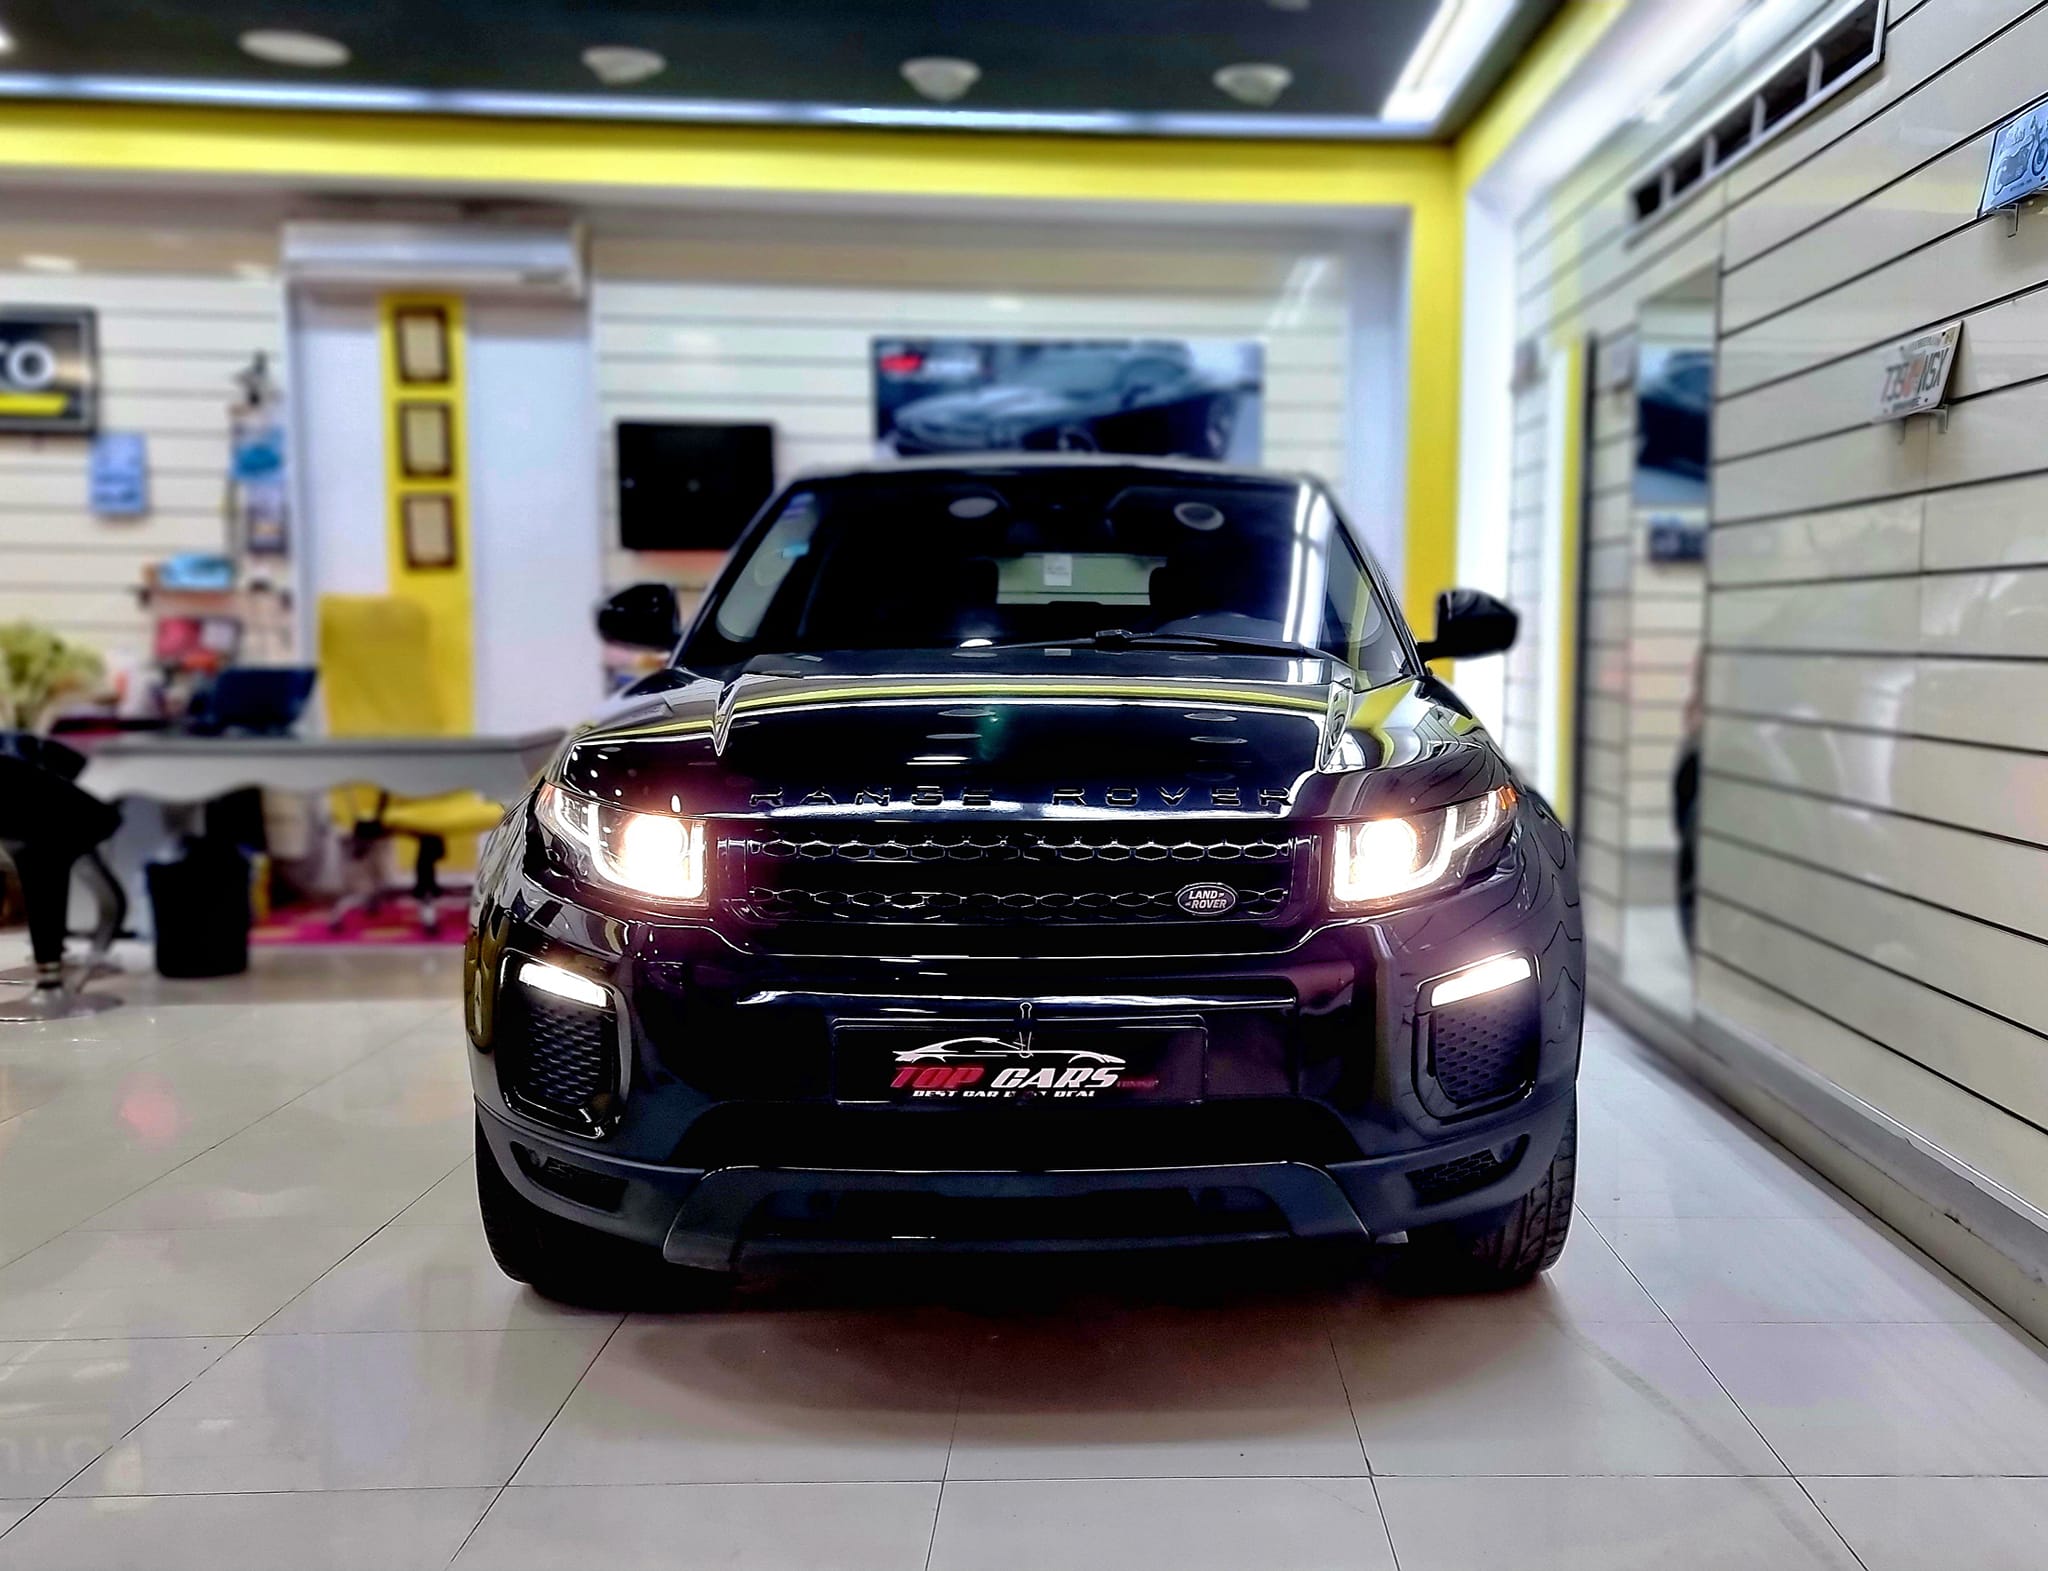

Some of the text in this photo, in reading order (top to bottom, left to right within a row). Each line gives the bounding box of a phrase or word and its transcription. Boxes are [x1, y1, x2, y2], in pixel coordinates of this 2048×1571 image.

[748, 785, 1292, 807] RANGE ROVER
[1188, 890, 1218, 900] LAND
[1190, 899, 1227, 909] ROVER
[890, 1066, 985, 1088] TOP
[991, 1066, 1126, 1088] CARS
